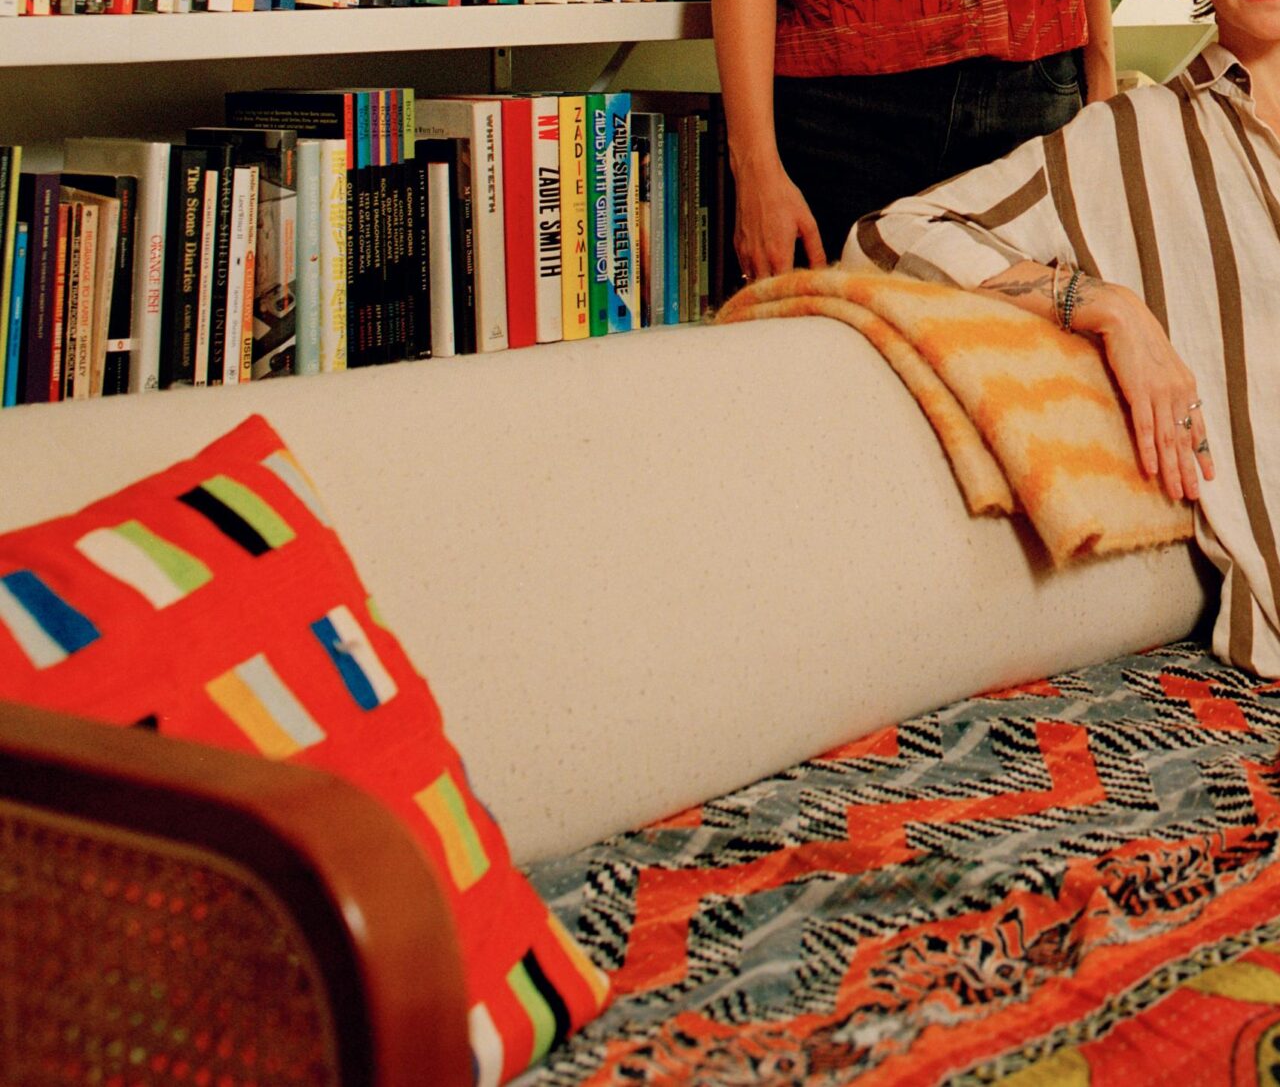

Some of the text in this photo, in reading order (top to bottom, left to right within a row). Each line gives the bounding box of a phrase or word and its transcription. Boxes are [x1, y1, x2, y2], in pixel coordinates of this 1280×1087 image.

[187, 167, 200, 194] The
[538, 115, 561, 278] NW ZADIE SMITH
[185, 198, 199, 236] Stone
[150, 235, 163, 284] ORANGE
[183, 242, 197, 292] Diaries
[213, 167, 232, 362] CAROL SHIELDS UNLESS
[613, 260, 630, 294] FREE
